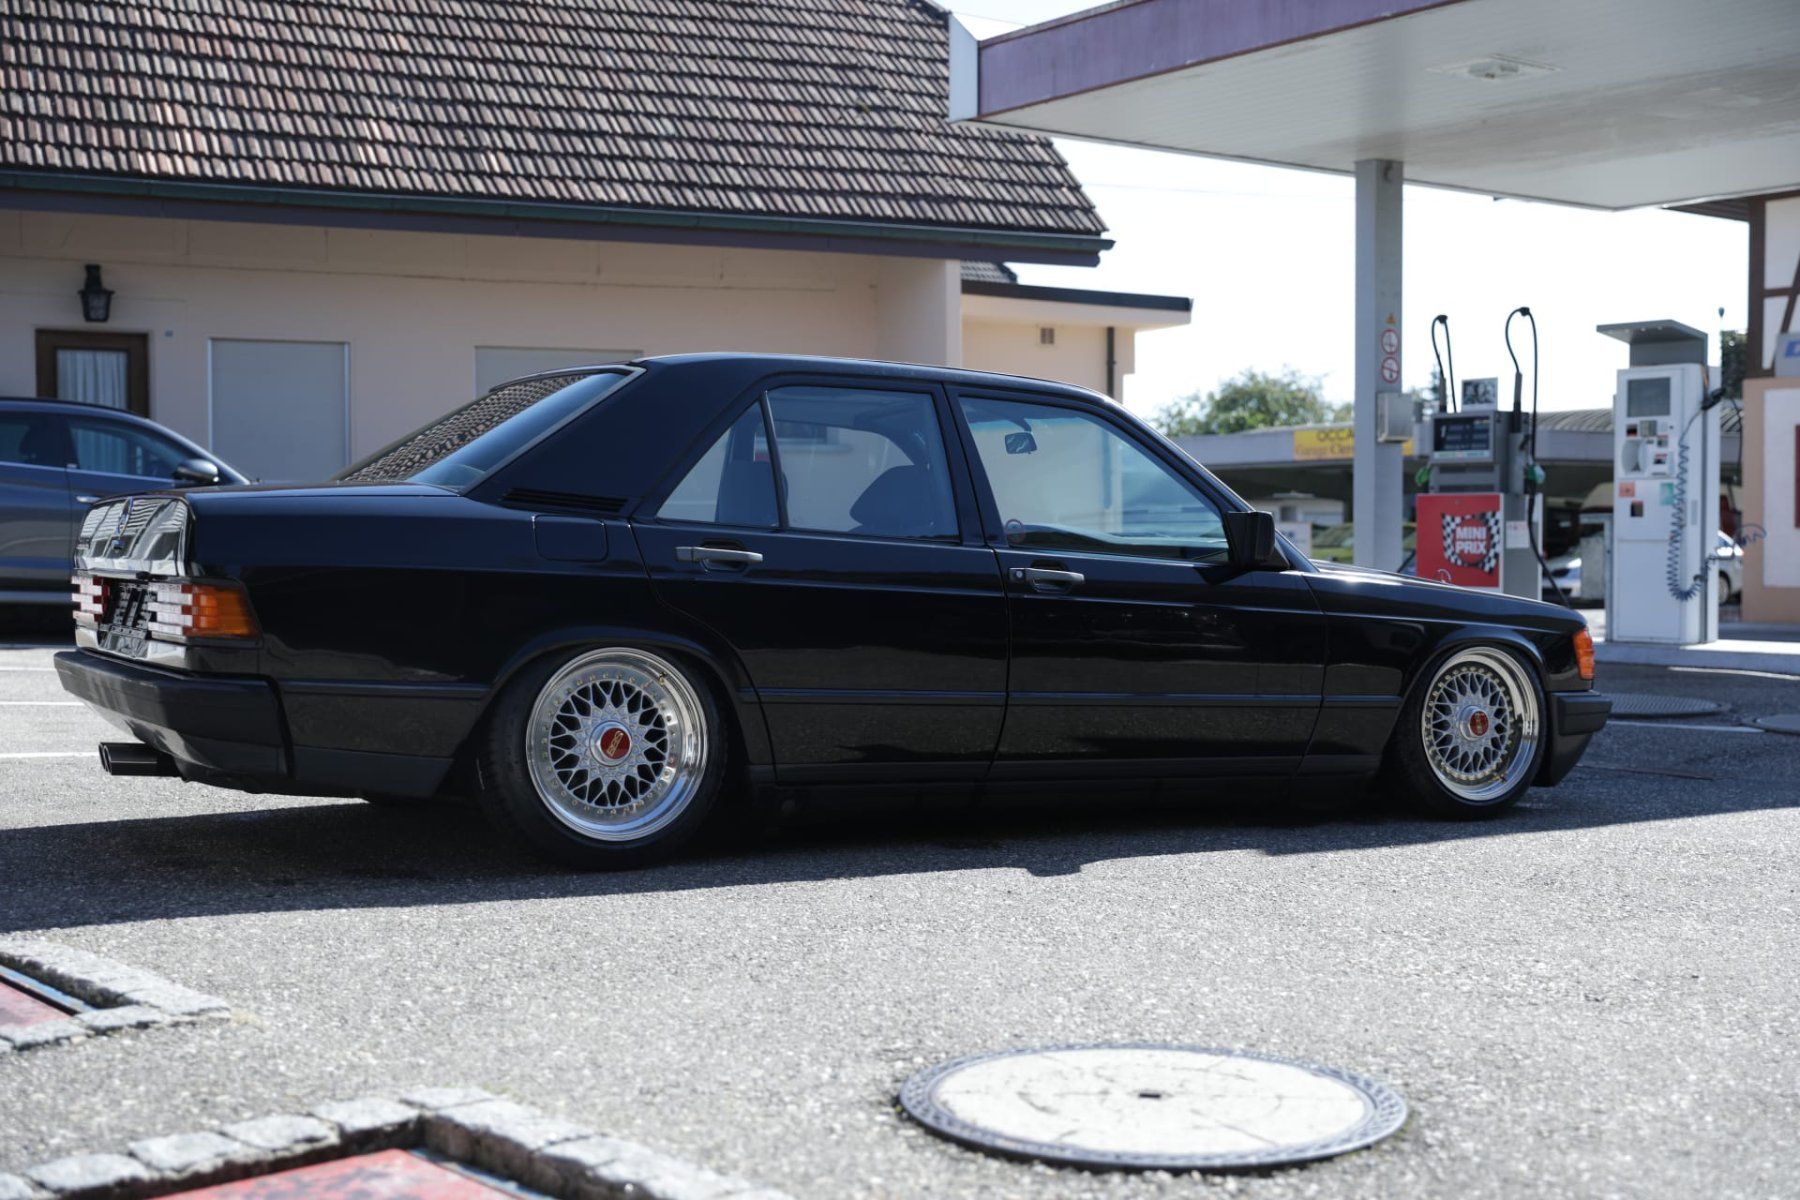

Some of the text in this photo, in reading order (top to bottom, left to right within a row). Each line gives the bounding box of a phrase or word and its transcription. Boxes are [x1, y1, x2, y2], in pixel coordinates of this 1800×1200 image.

[1456, 526, 1487, 540] MINI
[1454, 540, 1487, 555] PRIX
[606, 730, 624, 757] BBS
